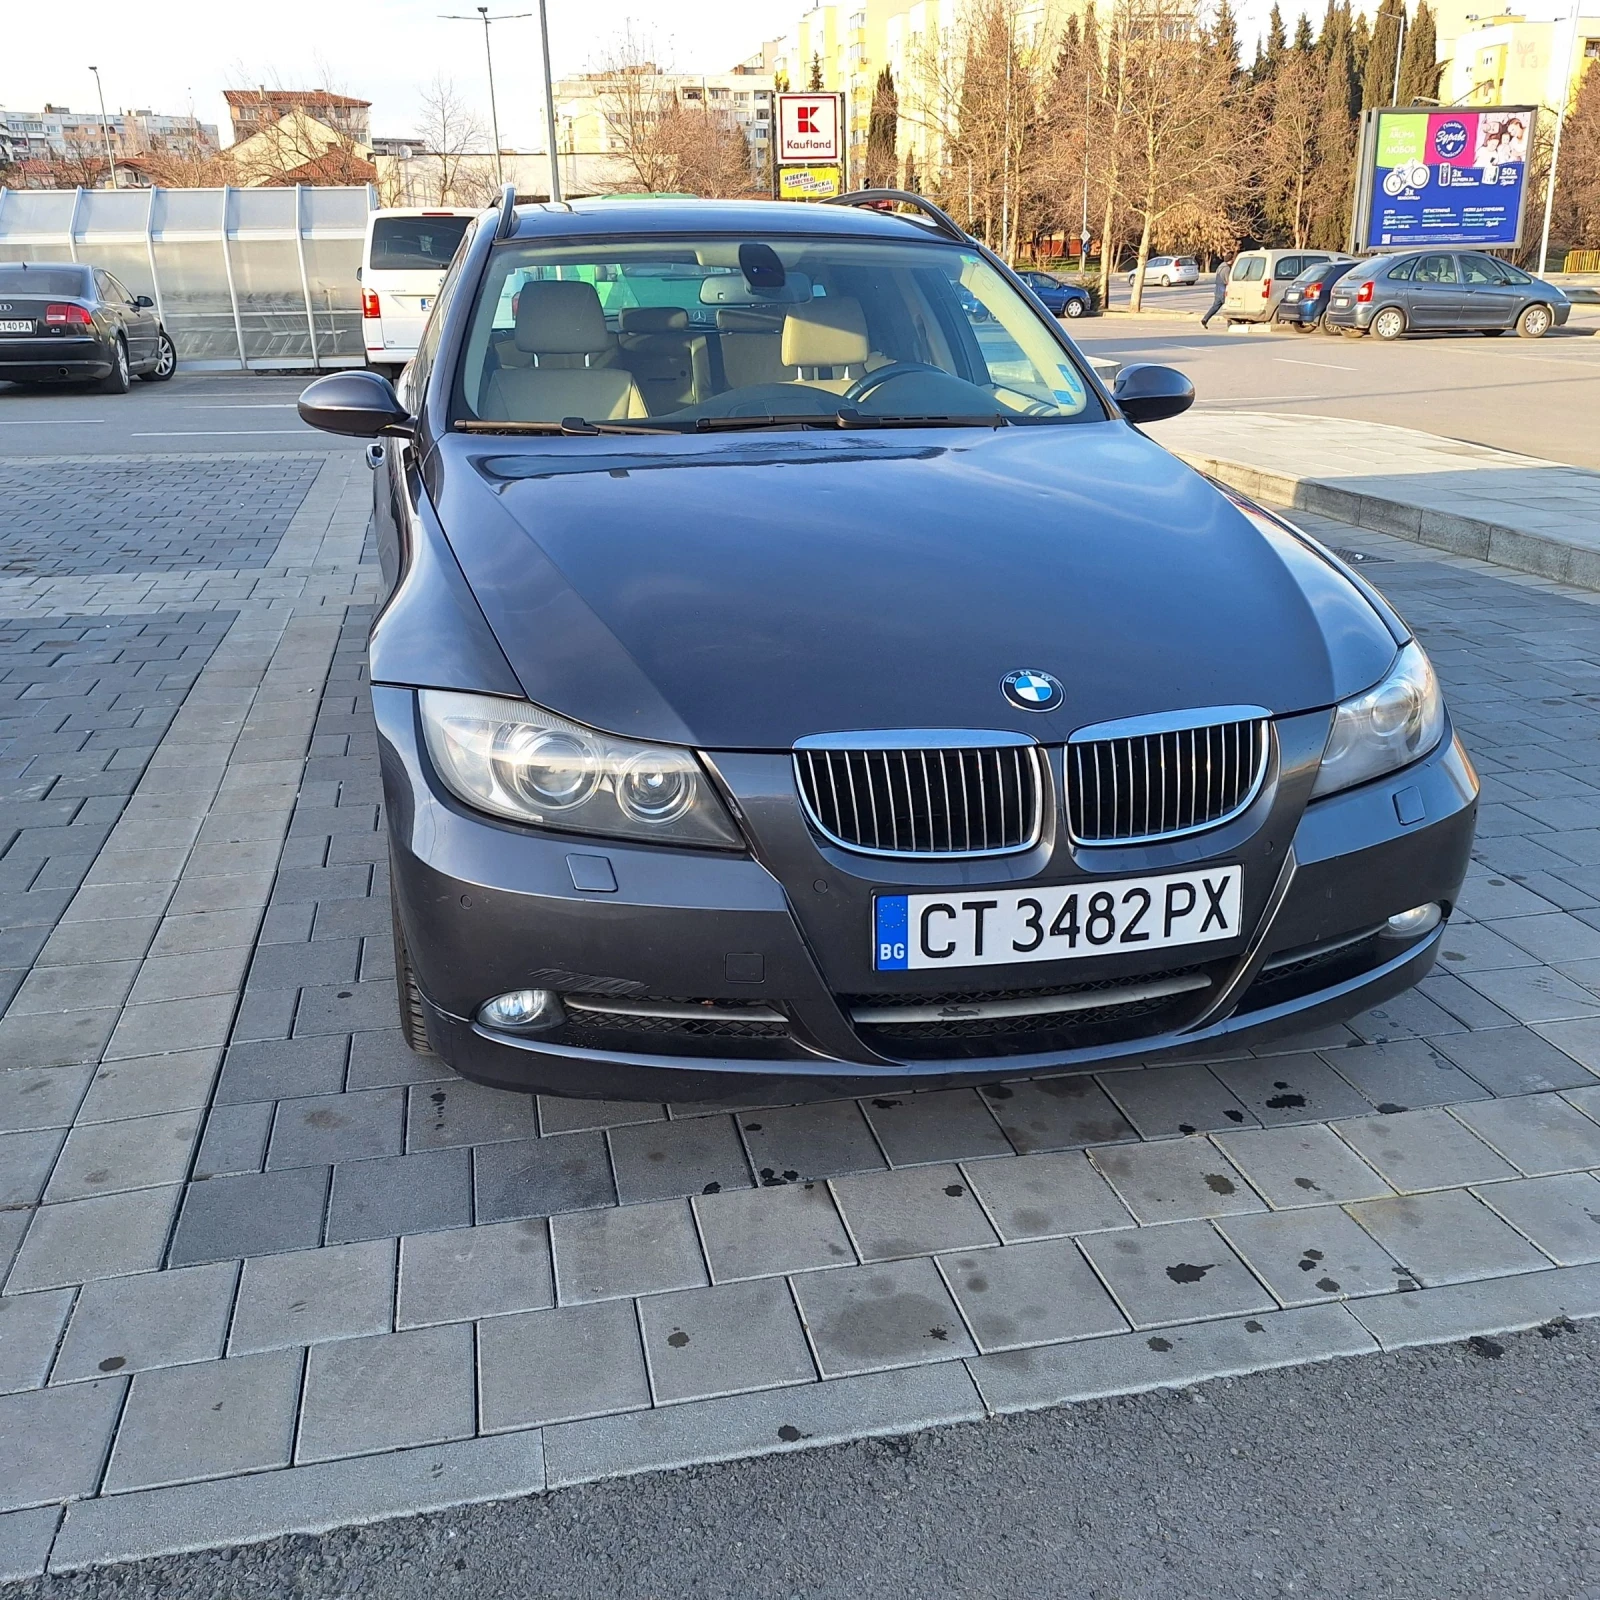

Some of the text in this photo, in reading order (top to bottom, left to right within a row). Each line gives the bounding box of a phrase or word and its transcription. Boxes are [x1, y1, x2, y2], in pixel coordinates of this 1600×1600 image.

[1435, 130, 1467, 146] Здраве
[786, 139, 832, 149] Kaufland
[1385, 145, 1417, 155] ЛЮБОВ
[784, 172, 808, 182] ИЗБЕРИ
[788, 176, 814, 186] КАЧЕСТВО
[809, 180, 830, 189] НИСКА
[0, 322, 17, 331] 140
[1005, 670, 1052, 684] BMW
[1012, 887, 1151, 953] 3482
[1163, 875, 1231, 938] PX
[879, 943, 905, 961] BG
